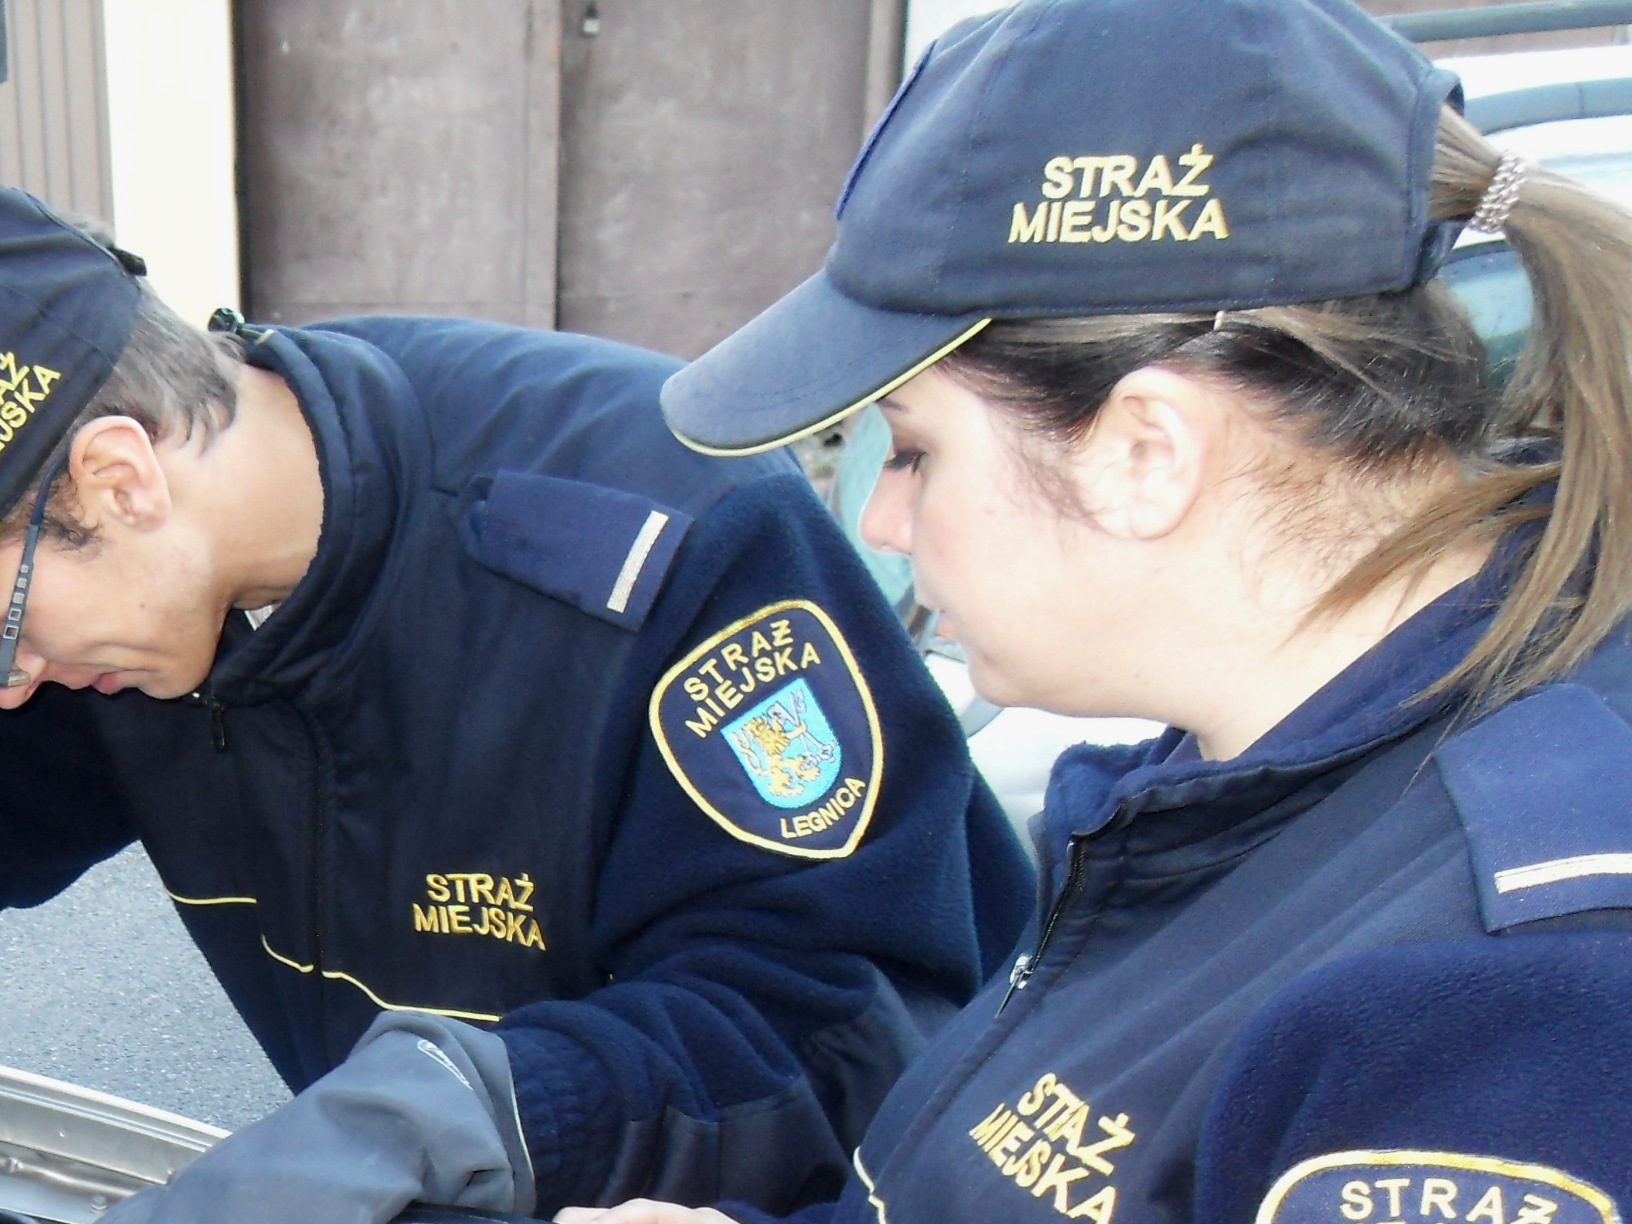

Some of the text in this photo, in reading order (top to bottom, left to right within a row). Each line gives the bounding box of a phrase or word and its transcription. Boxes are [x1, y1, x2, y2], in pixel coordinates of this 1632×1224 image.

[1041, 142, 1214, 198] STRAŻ
[1007, 198, 1230, 244] MIEJSKA
[684, 642, 821, 739] MIEJSKA
[779, 775, 867, 840] LEGNICA
[425, 872, 535, 912] STRAŻ
[412, 903, 547, 951] MIEJSKA
